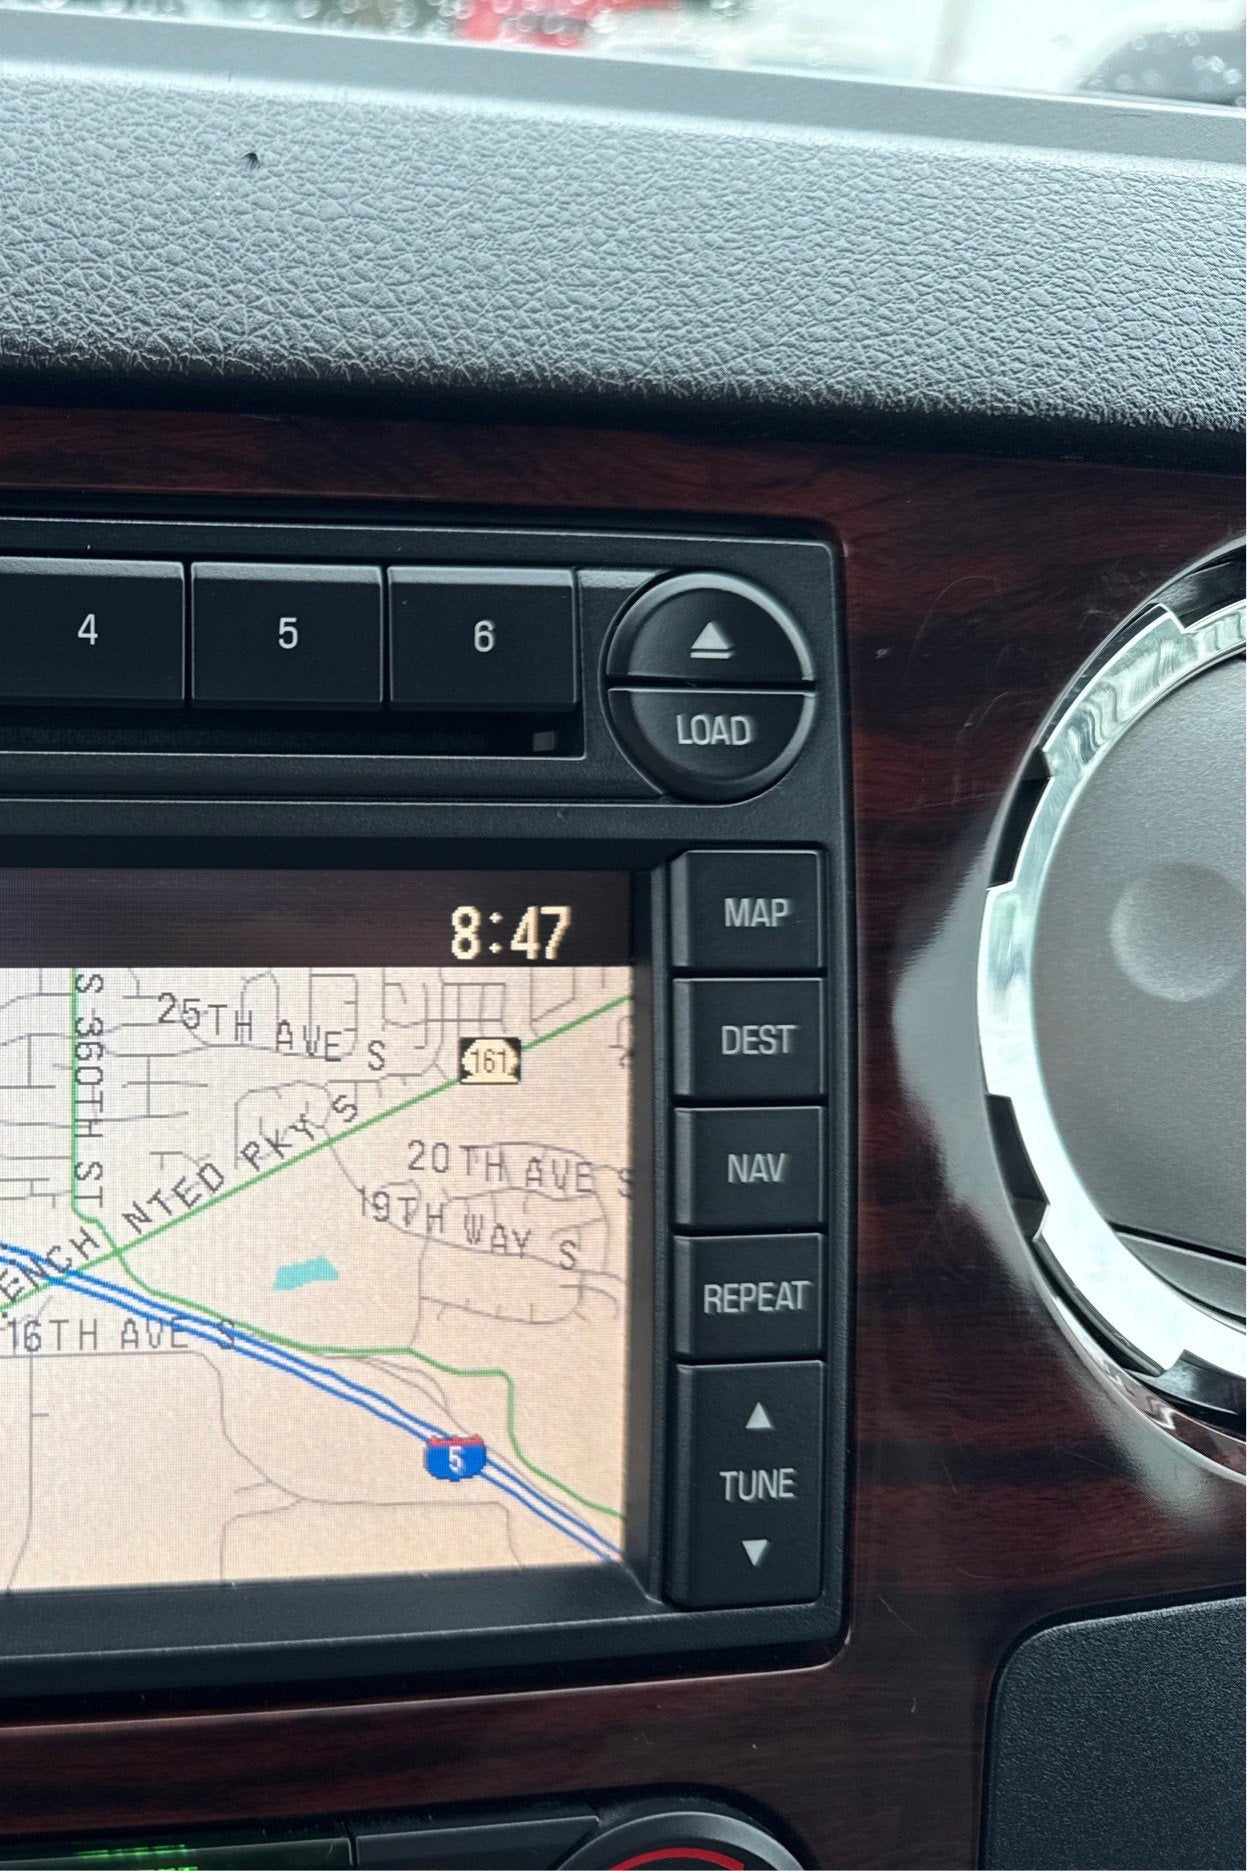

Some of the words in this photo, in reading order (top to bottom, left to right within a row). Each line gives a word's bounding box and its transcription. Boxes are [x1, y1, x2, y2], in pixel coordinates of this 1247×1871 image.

[77, 613, 99, 646] 4
[277, 616, 299, 650] 5
[473, 619, 496, 653] 6
[675, 713, 752, 748] LOAD
[723, 897, 790, 928] MAP
[451, 905, 573, 960] 8:47
[74, 973, 104, 993] S
[156, 991, 254, 1043] 25TH
[275, 1018, 342, 1062] AVE
[367, 1039, 386, 1071] S
[720, 1024, 798, 1056] DEST
[74, 1017, 104, 1138] 360TH
[469, 1047, 508, 1074] 161
[240, 1112, 316, 1172] PKY
[331, 1093, 359, 1124] S
[407, 1139, 504, 1182] 20TH
[525, 1156, 594, 1194] AVE
[726, 1152, 788, 1184] NAV
[74, 1161, 104, 1208] ST
[360, 1184, 444, 1235] 19TH
[463, 1212, 532, 1259] WAY
[558, 1238, 577, 1271] S
[702, 1279, 813, 1315] REPEAT
[8, 1317, 98, 1352] 16TH
[120, 1316, 189, 1350] AVE
[447, 1446, 464, 1473] 5
[718, 1467, 797, 1502] TUNE
